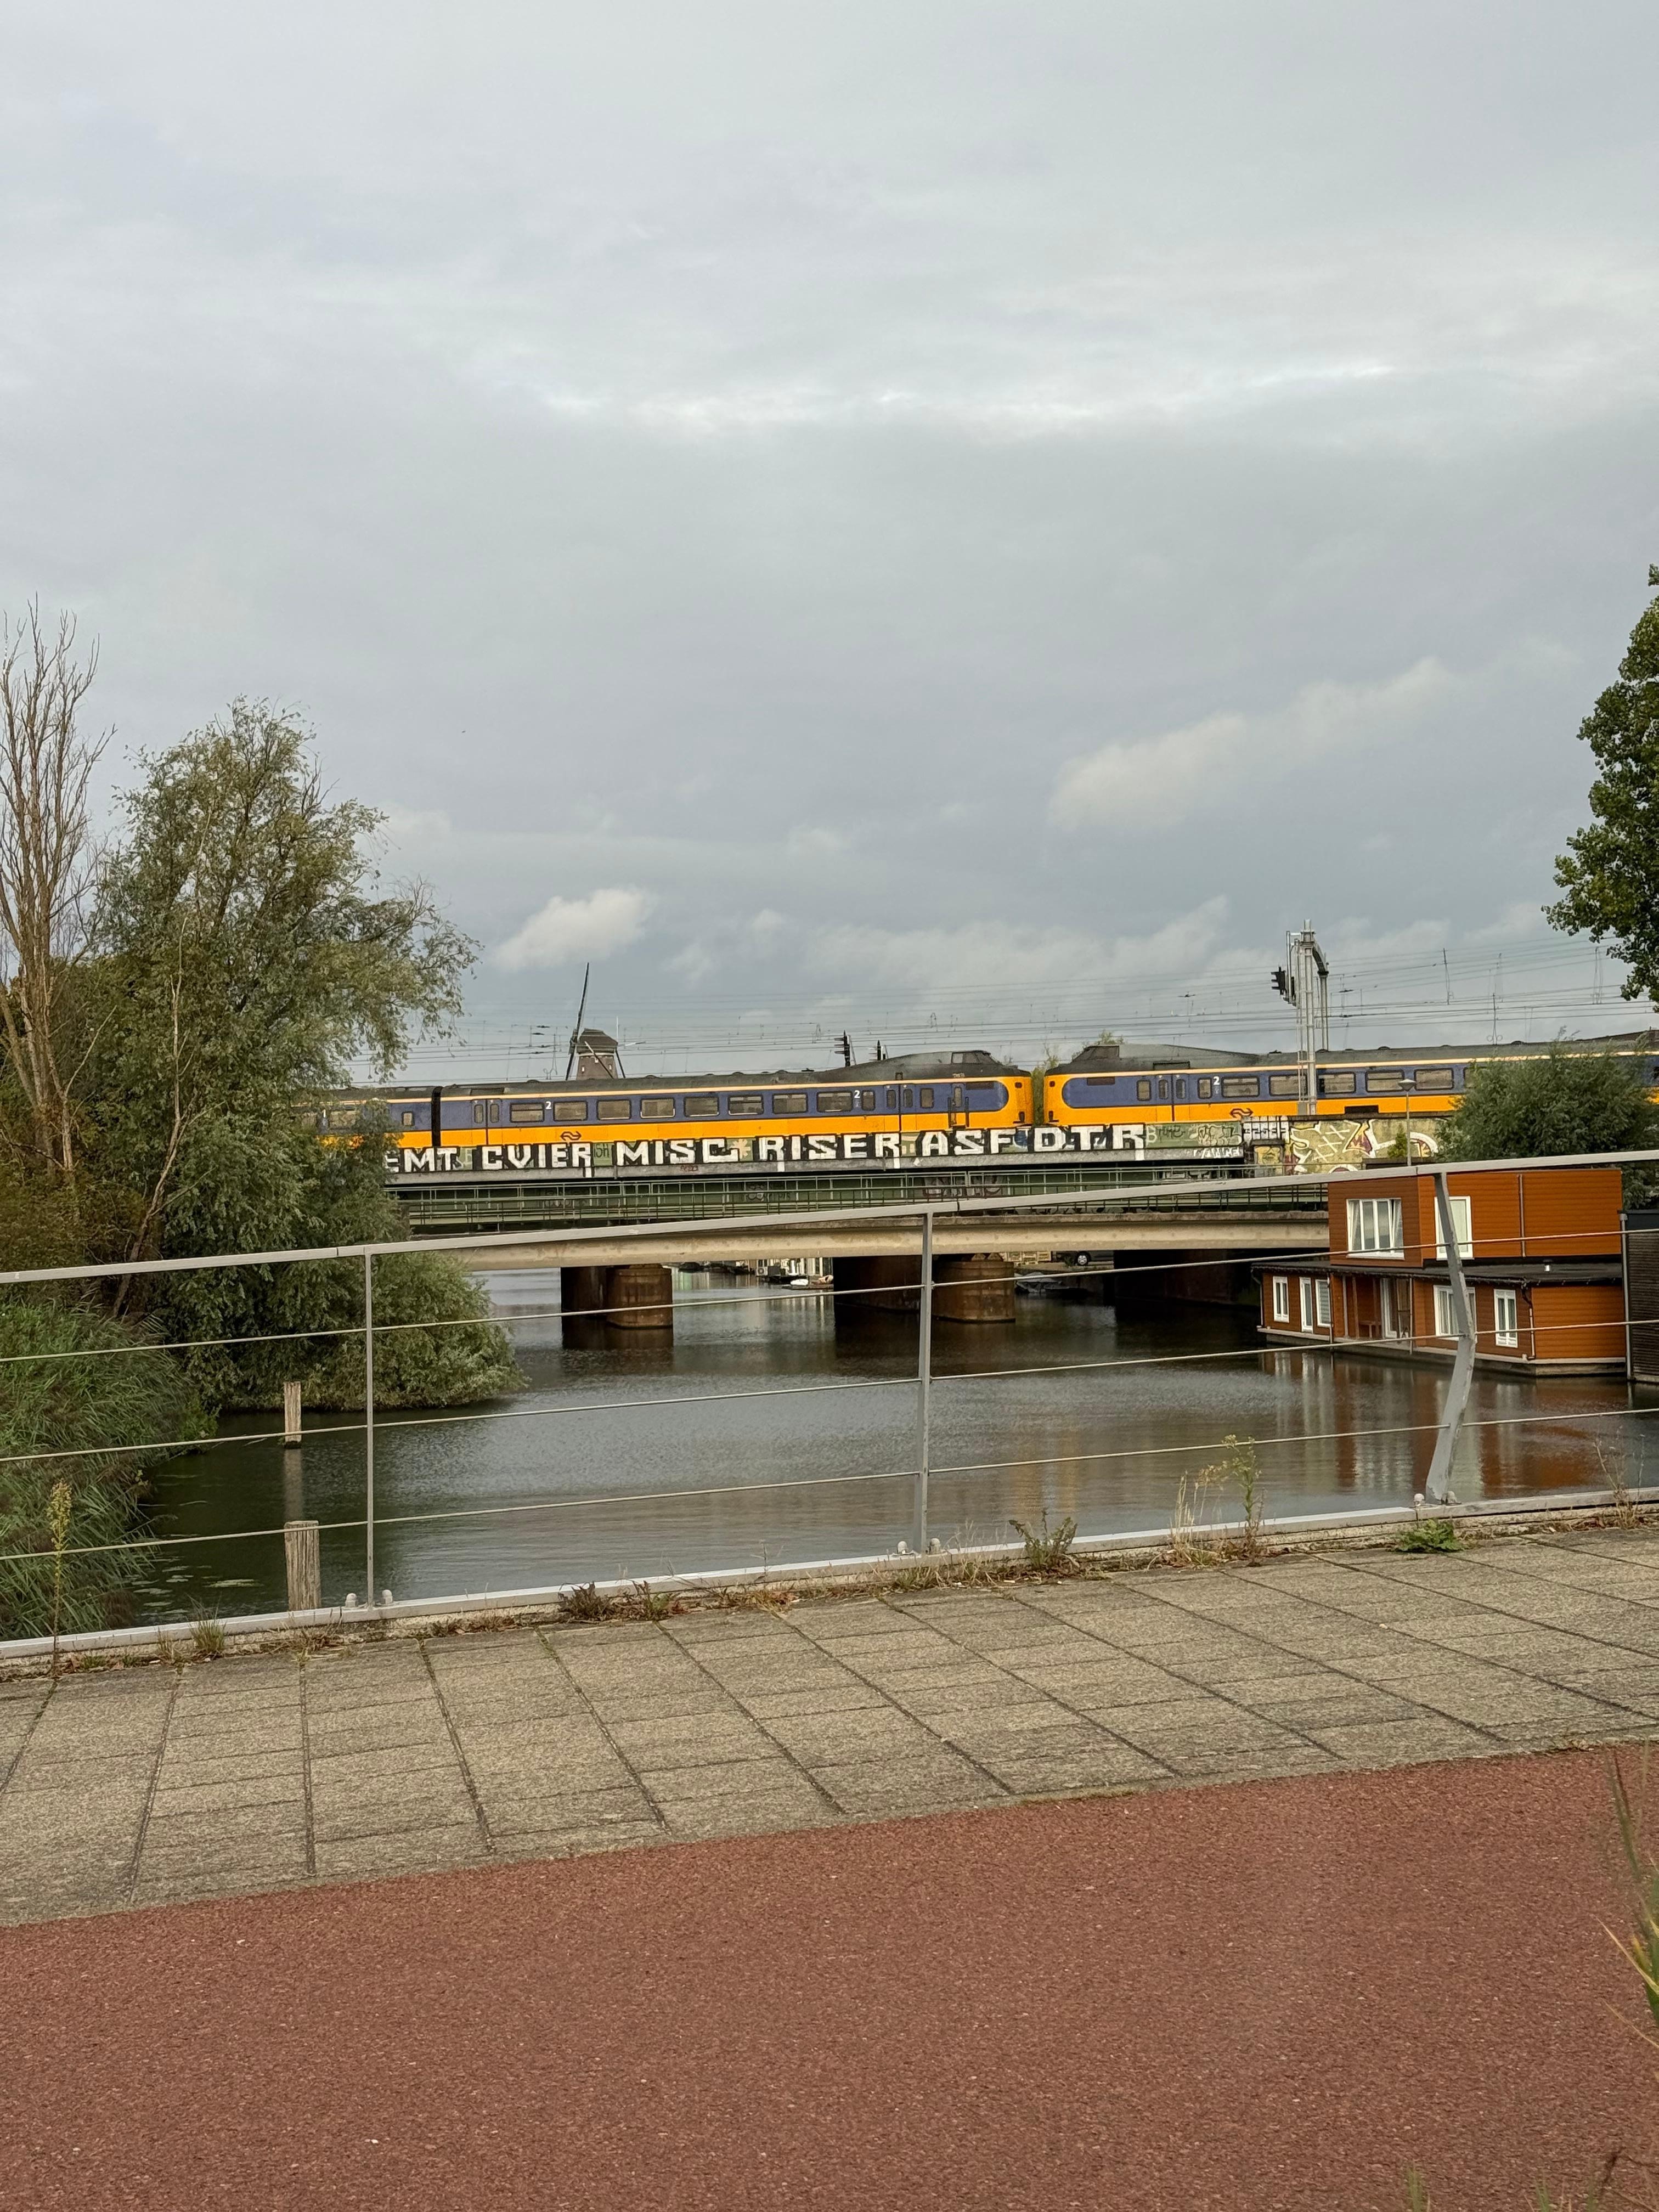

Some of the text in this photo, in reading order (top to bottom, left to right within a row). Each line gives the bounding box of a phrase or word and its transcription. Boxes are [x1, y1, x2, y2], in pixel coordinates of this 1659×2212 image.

[1213, 1076, 1220, 1085] 2
[854, 1090, 860, 1098] 2
[546, 1101, 552, 1109] 2
[616, 1138, 739, 1166] MISC
[758, 1133, 900, 1172] RISER
